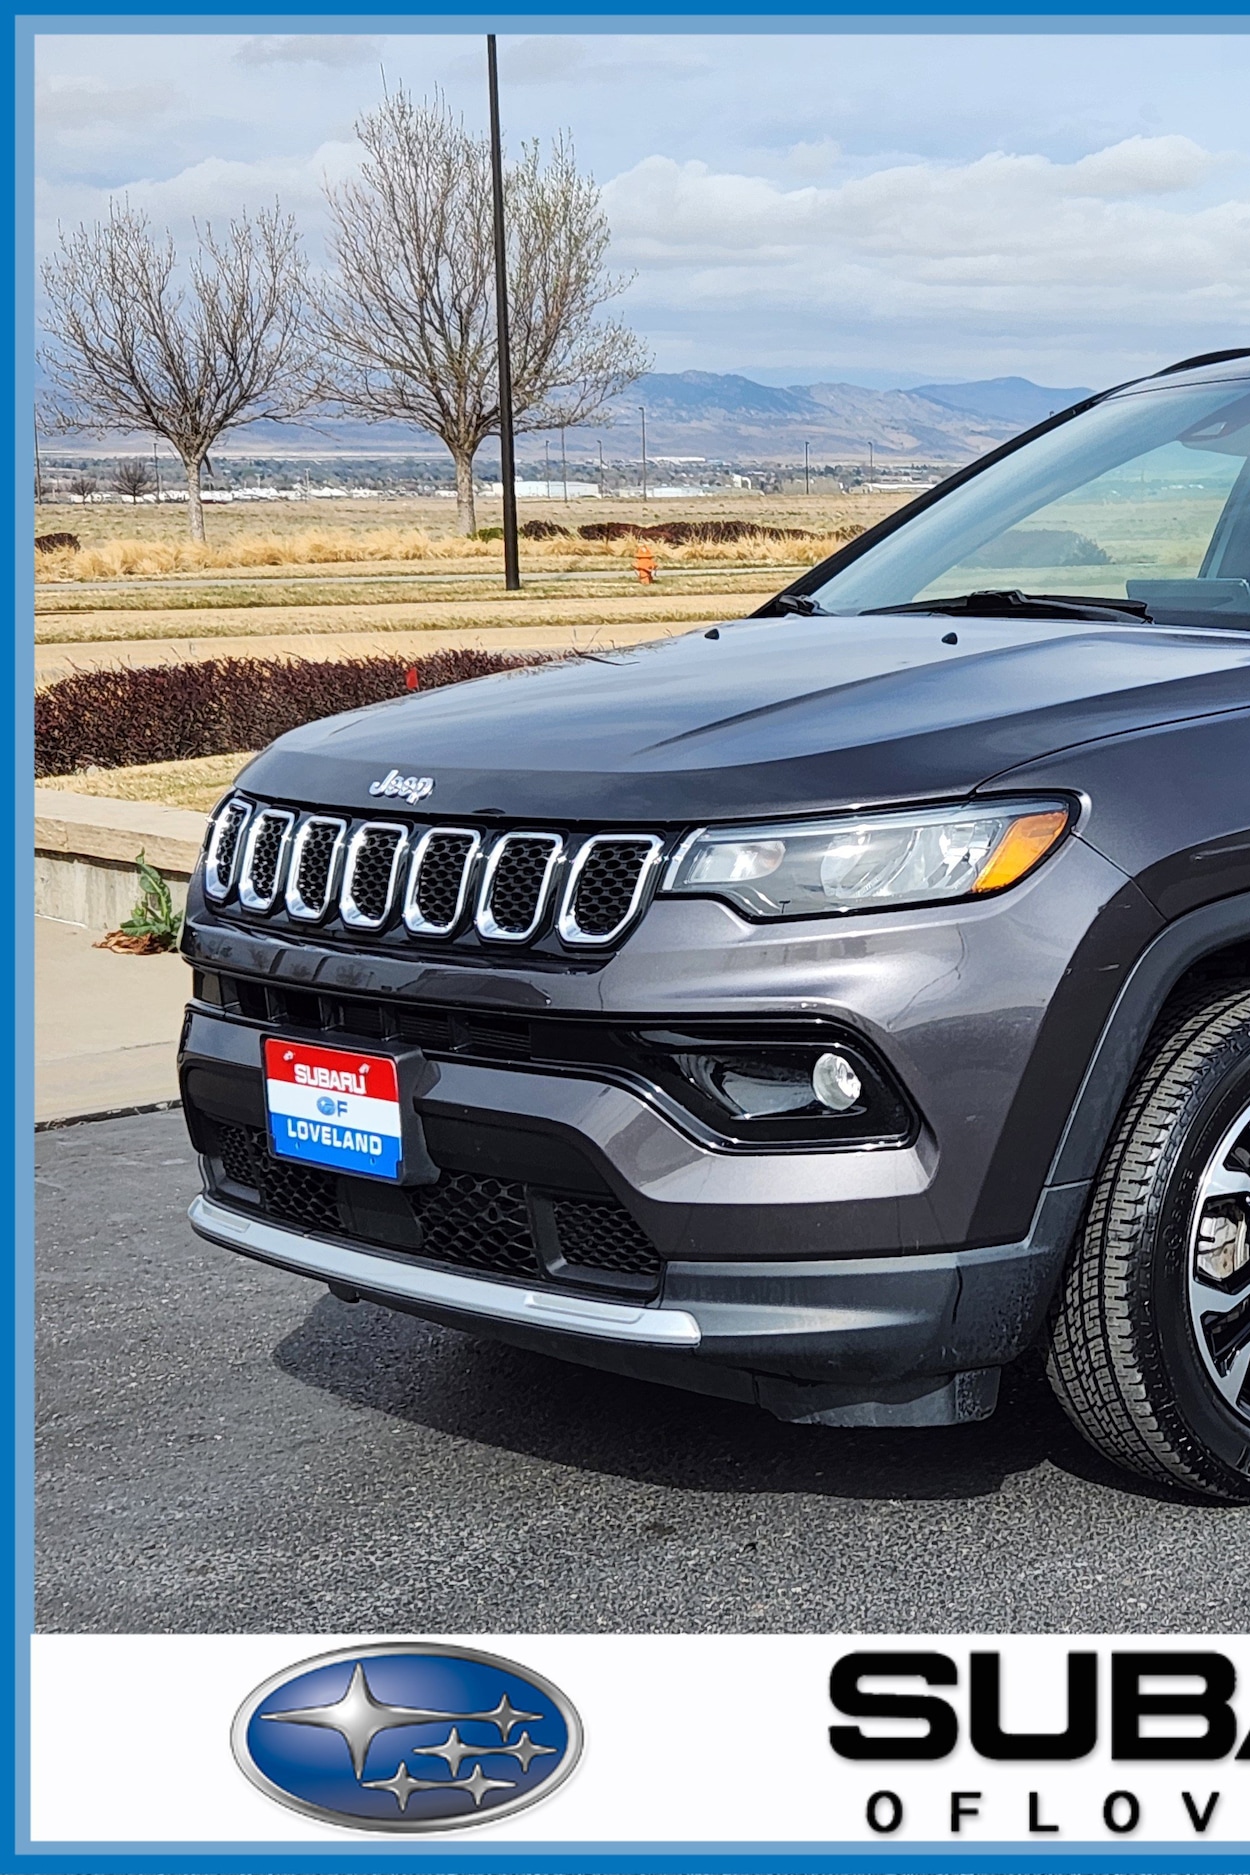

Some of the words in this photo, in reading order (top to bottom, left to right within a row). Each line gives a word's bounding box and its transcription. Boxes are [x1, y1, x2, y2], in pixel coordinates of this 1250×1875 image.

[369, 769, 434, 806] Jeep
[294, 1063, 367, 1095] SUBARU
[287, 1118, 383, 1156] LOVELAND
